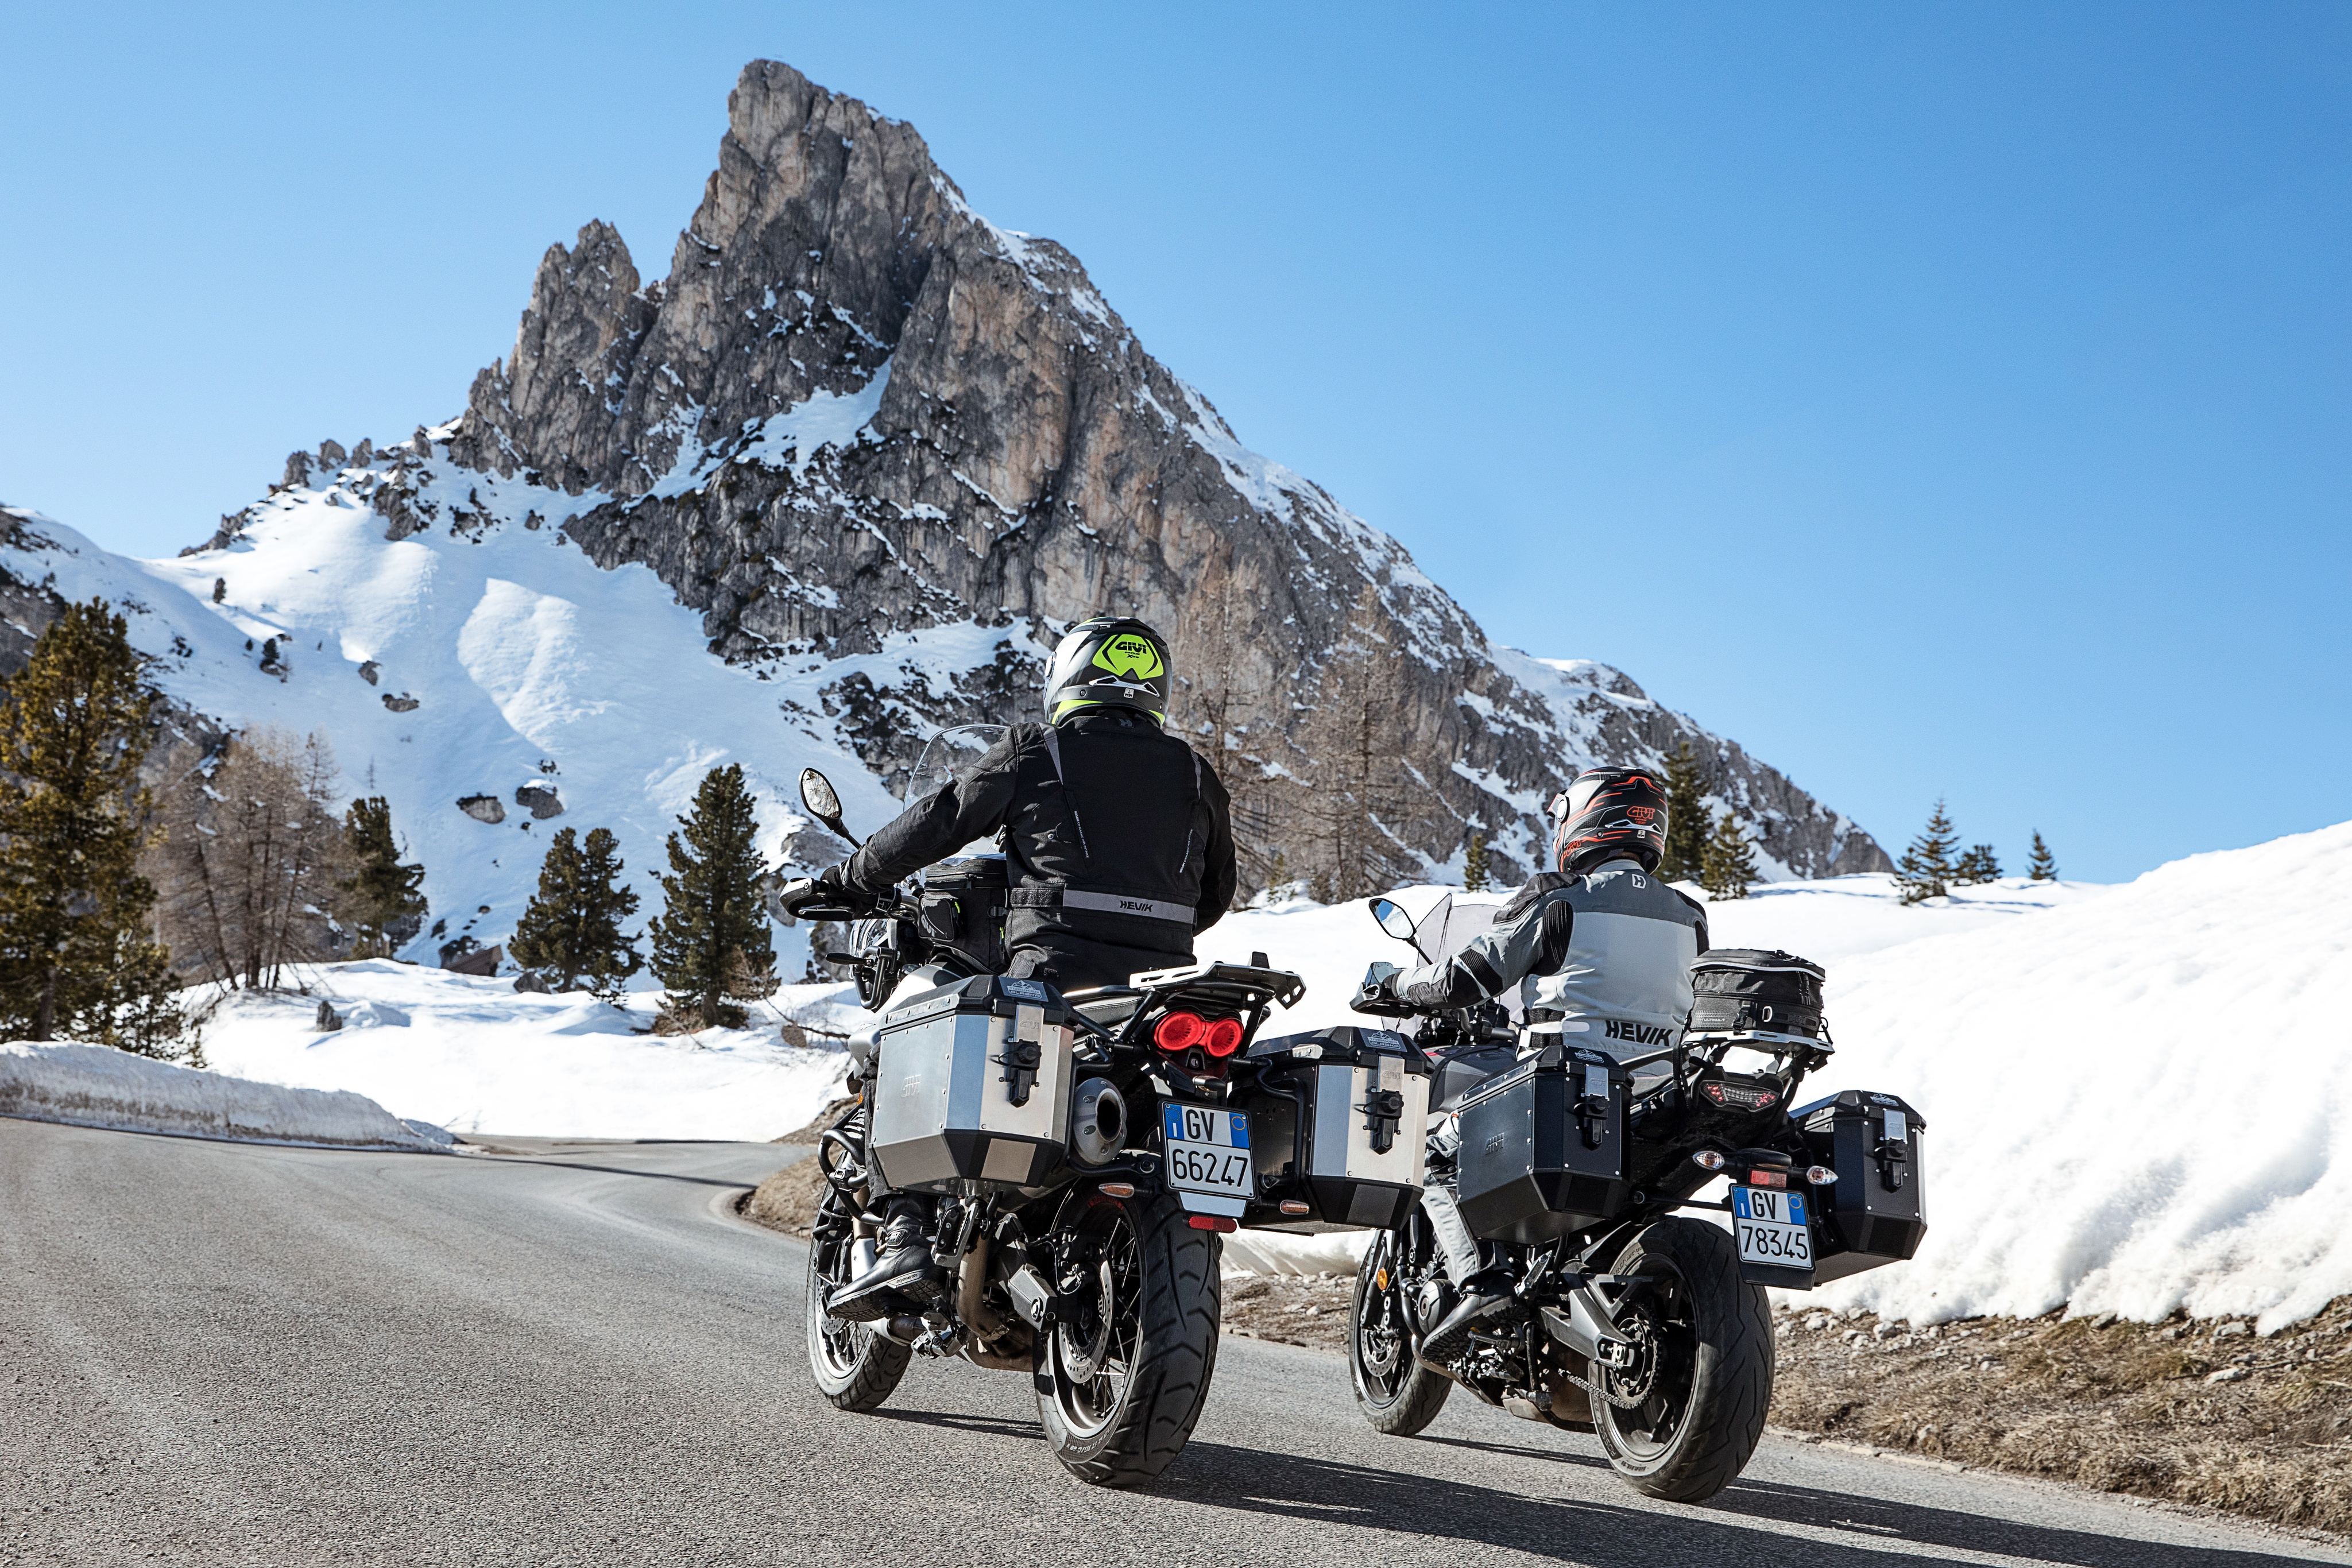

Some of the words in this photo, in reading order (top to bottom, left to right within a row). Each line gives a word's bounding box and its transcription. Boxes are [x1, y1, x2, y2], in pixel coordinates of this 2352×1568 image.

[1115, 641, 1147, 654] GIVI
[1627, 806, 1655, 819] GIVI
[1120, 900, 1153, 912] HEVIK
[1020, 1020, 1040, 1029] GIVI
[1605, 1020, 1674, 1047] HEVIK
[1186, 1109, 1214, 1142] GV
[1172, 1148, 1248, 1187] 66247
[1751, 1191, 1776, 1219] GV
[1741, 1225, 1808, 1260] 78345
[1599, 1426, 1616, 1457] ROSSO
